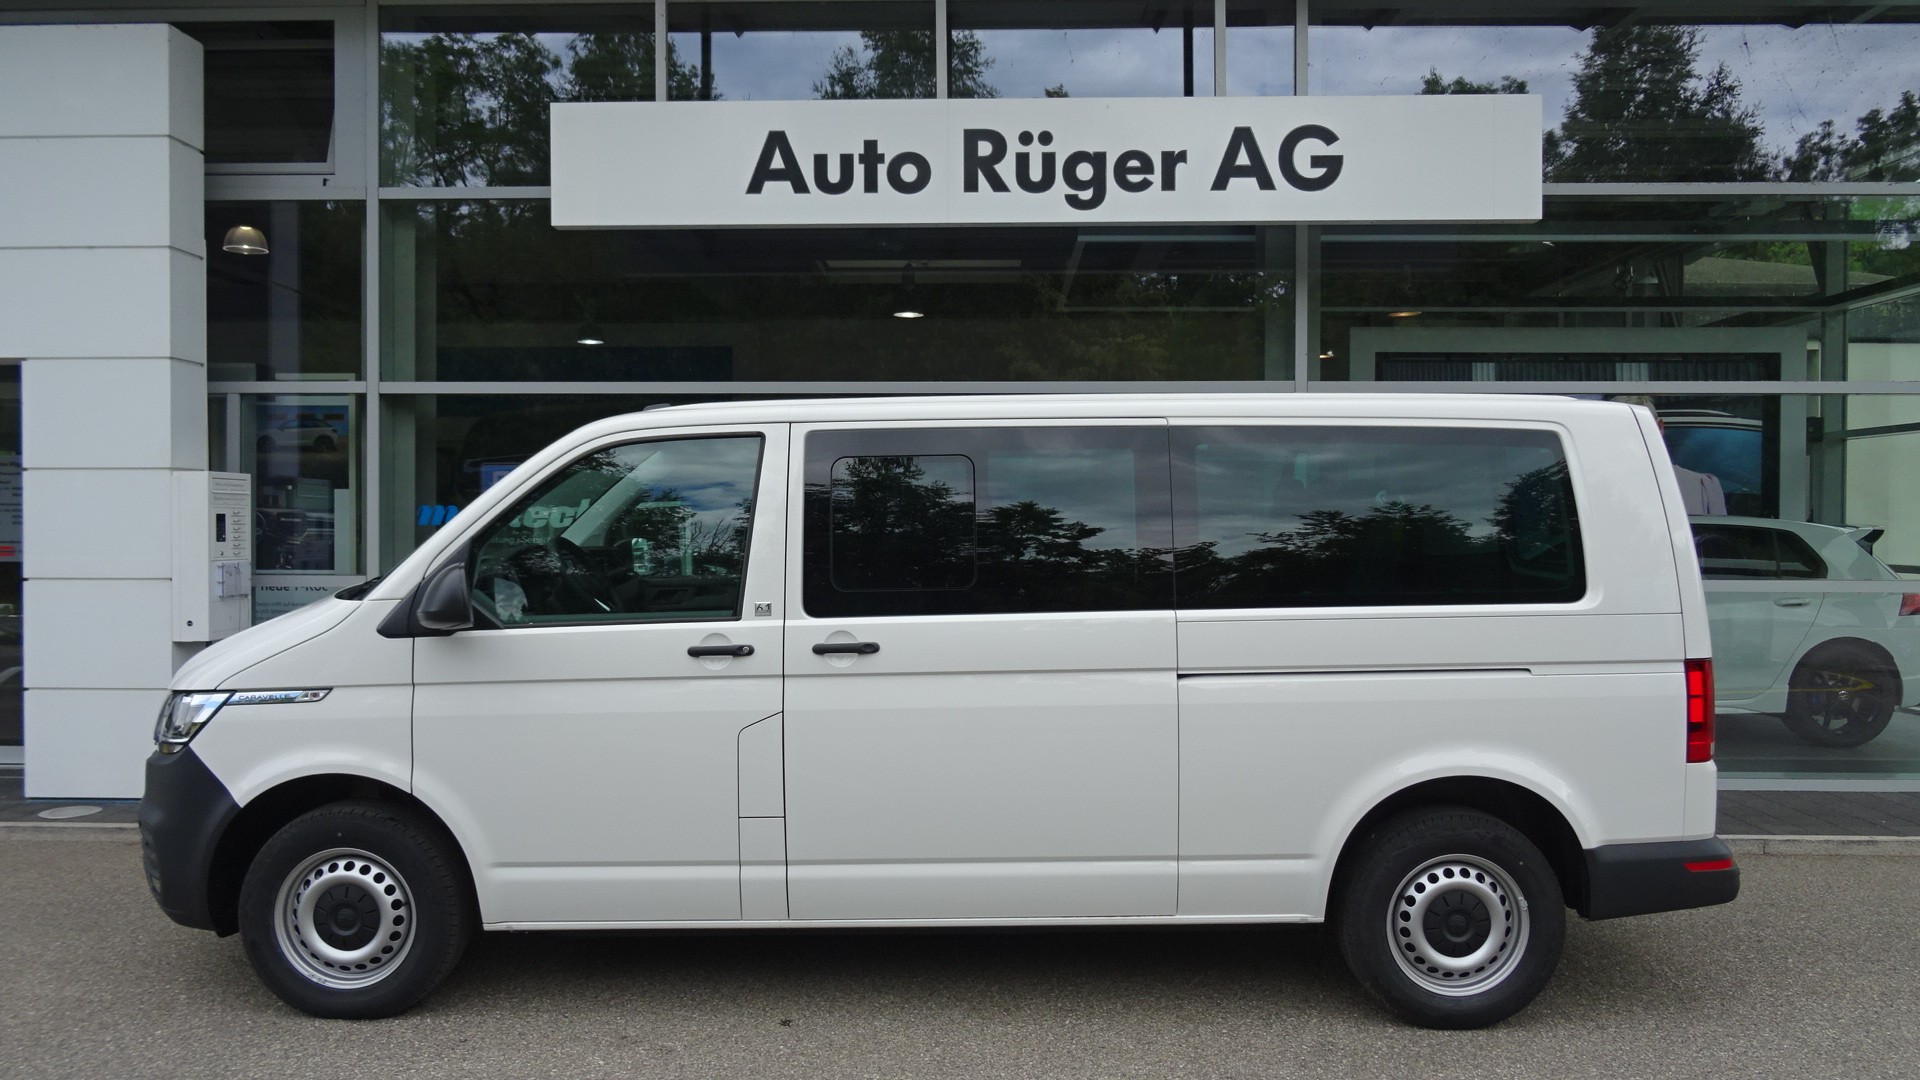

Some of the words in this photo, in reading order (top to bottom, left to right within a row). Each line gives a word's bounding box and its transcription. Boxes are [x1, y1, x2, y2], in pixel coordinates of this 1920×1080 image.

[746, 130, 931, 196] Auto
[963, 128, 1188, 211] Rüger
[1210, 124, 1344, 193] AG
[238, 693, 291, 701] CARAVELLE
